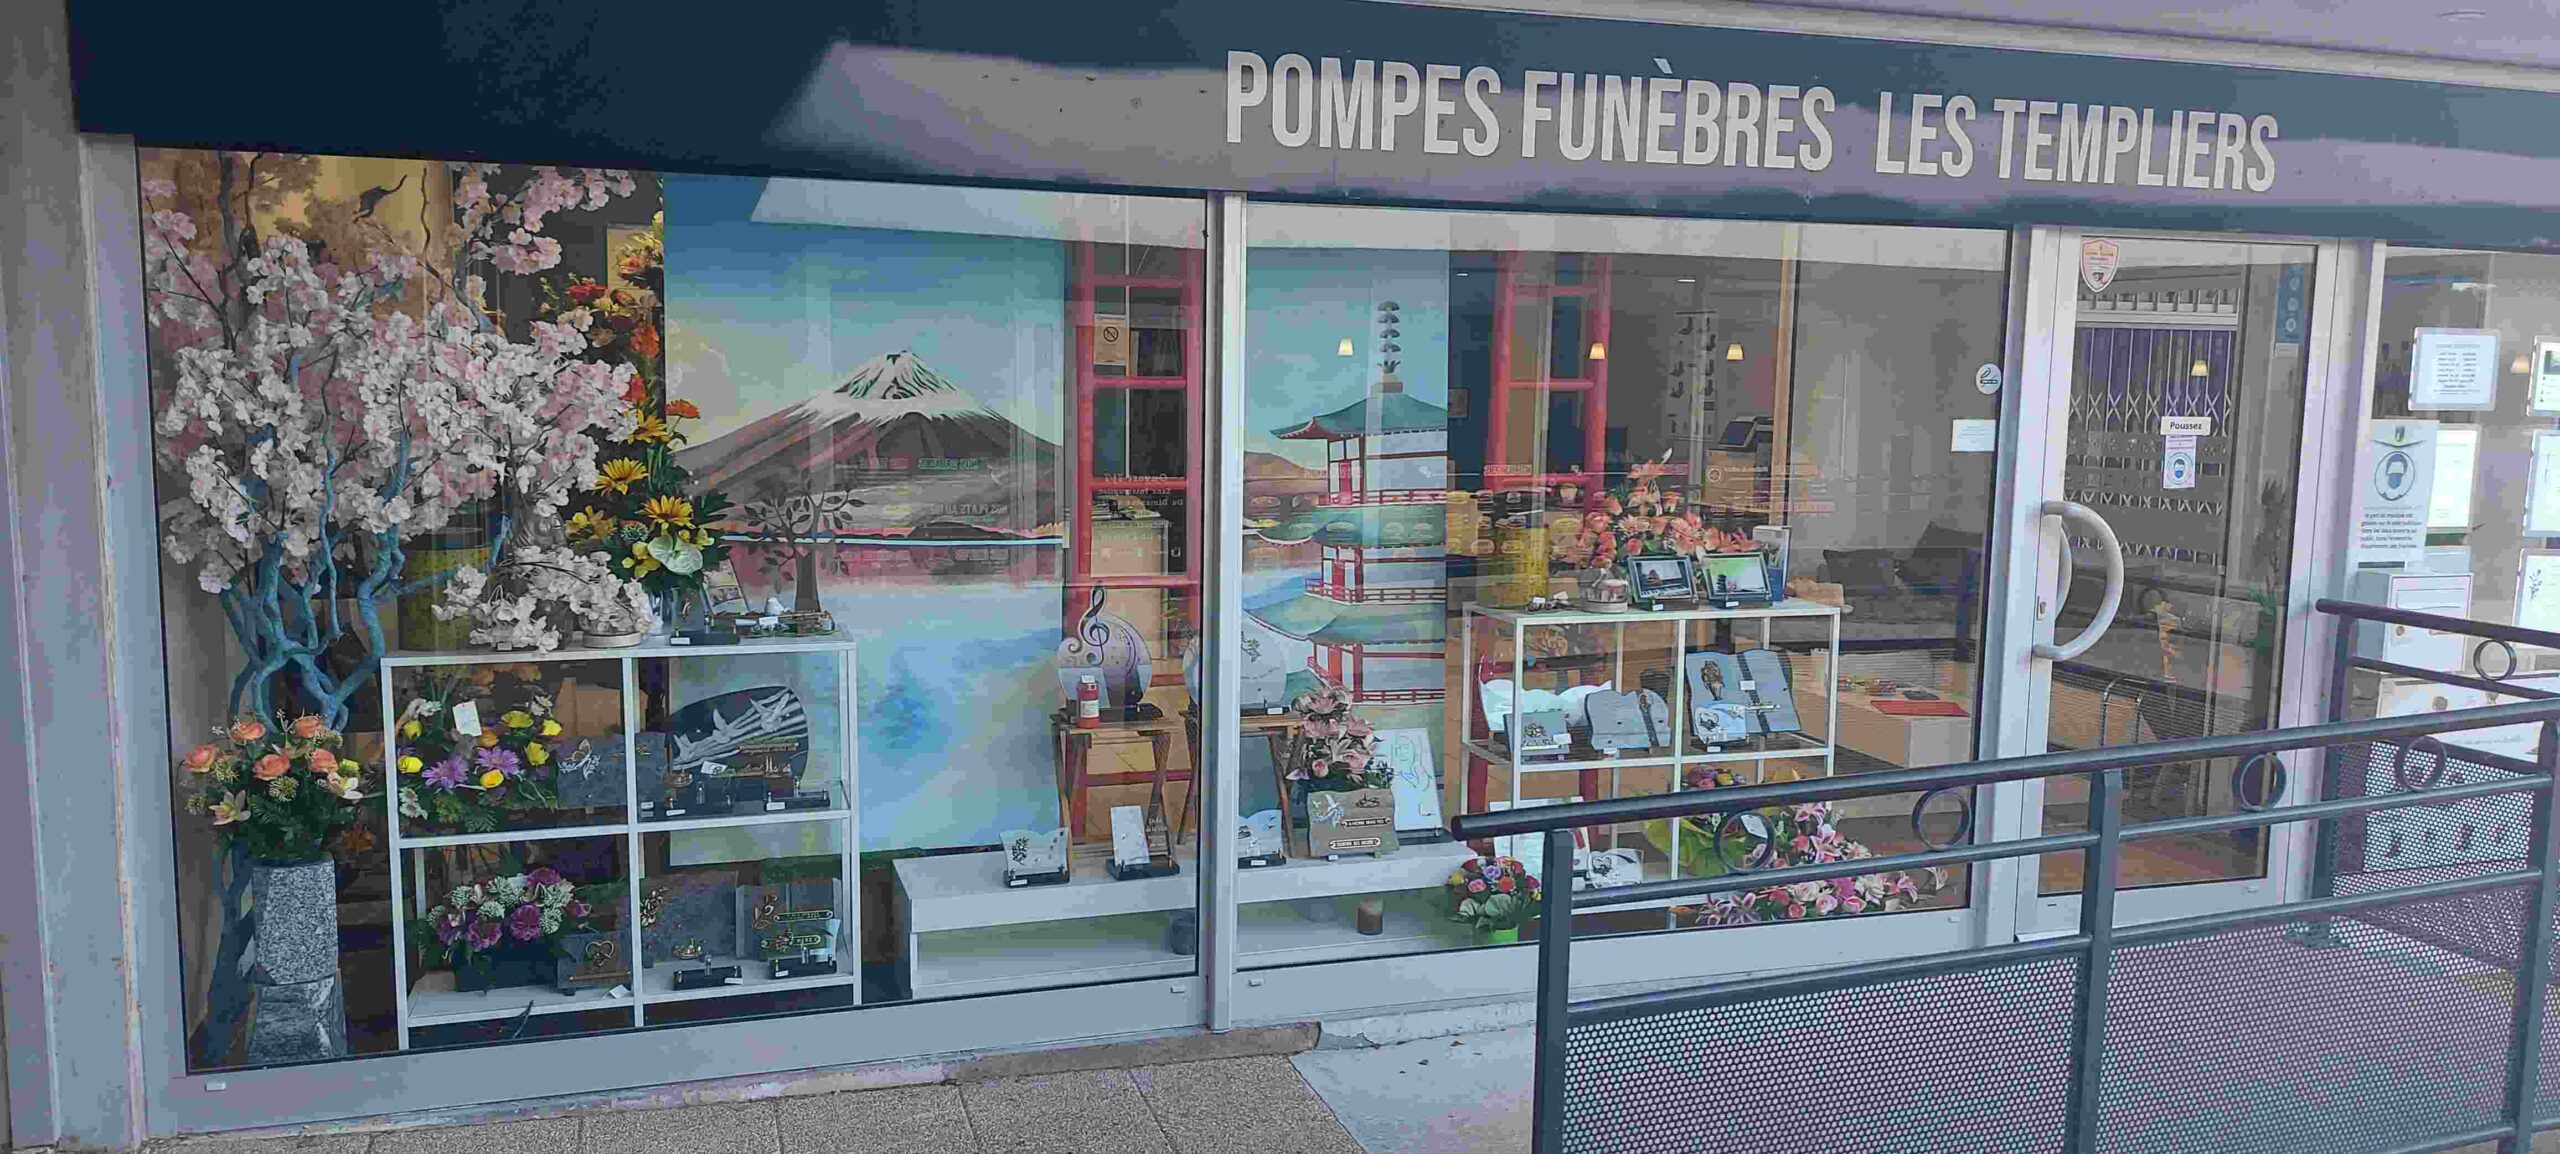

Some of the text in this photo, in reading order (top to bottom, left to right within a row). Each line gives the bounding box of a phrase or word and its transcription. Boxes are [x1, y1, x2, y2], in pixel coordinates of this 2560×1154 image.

[1226, 51, 2278, 193] POMPES FUNÈBRES LES TEMPLIERS
[2169, 421, 2202, 430] Poussez
